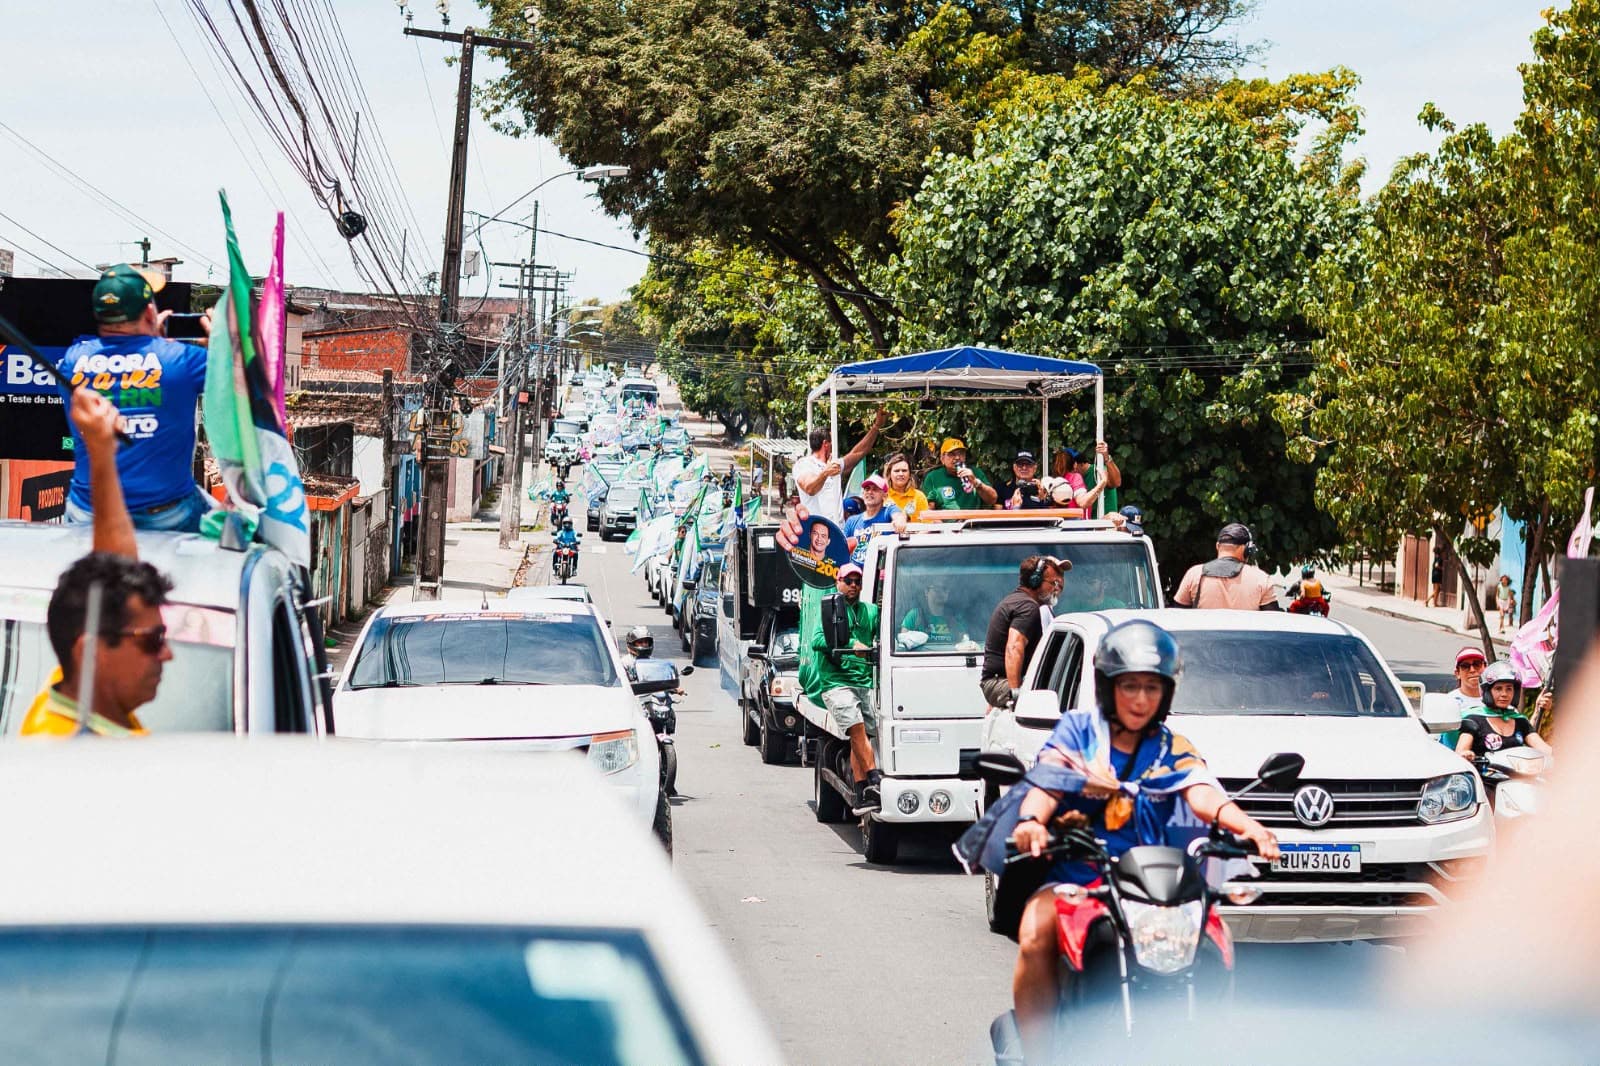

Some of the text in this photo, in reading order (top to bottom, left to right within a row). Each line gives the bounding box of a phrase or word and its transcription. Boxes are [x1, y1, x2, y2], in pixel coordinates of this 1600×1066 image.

[7, 354, 64, 386] Ba
[73, 352, 162, 373] AGORA
[7, 394, 31, 404] Teste
[34, 395, 46, 404] de
[48, 395, 65, 405] bat
[120, 388, 162, 407] RN
[782, 588, 803, 603] 99
